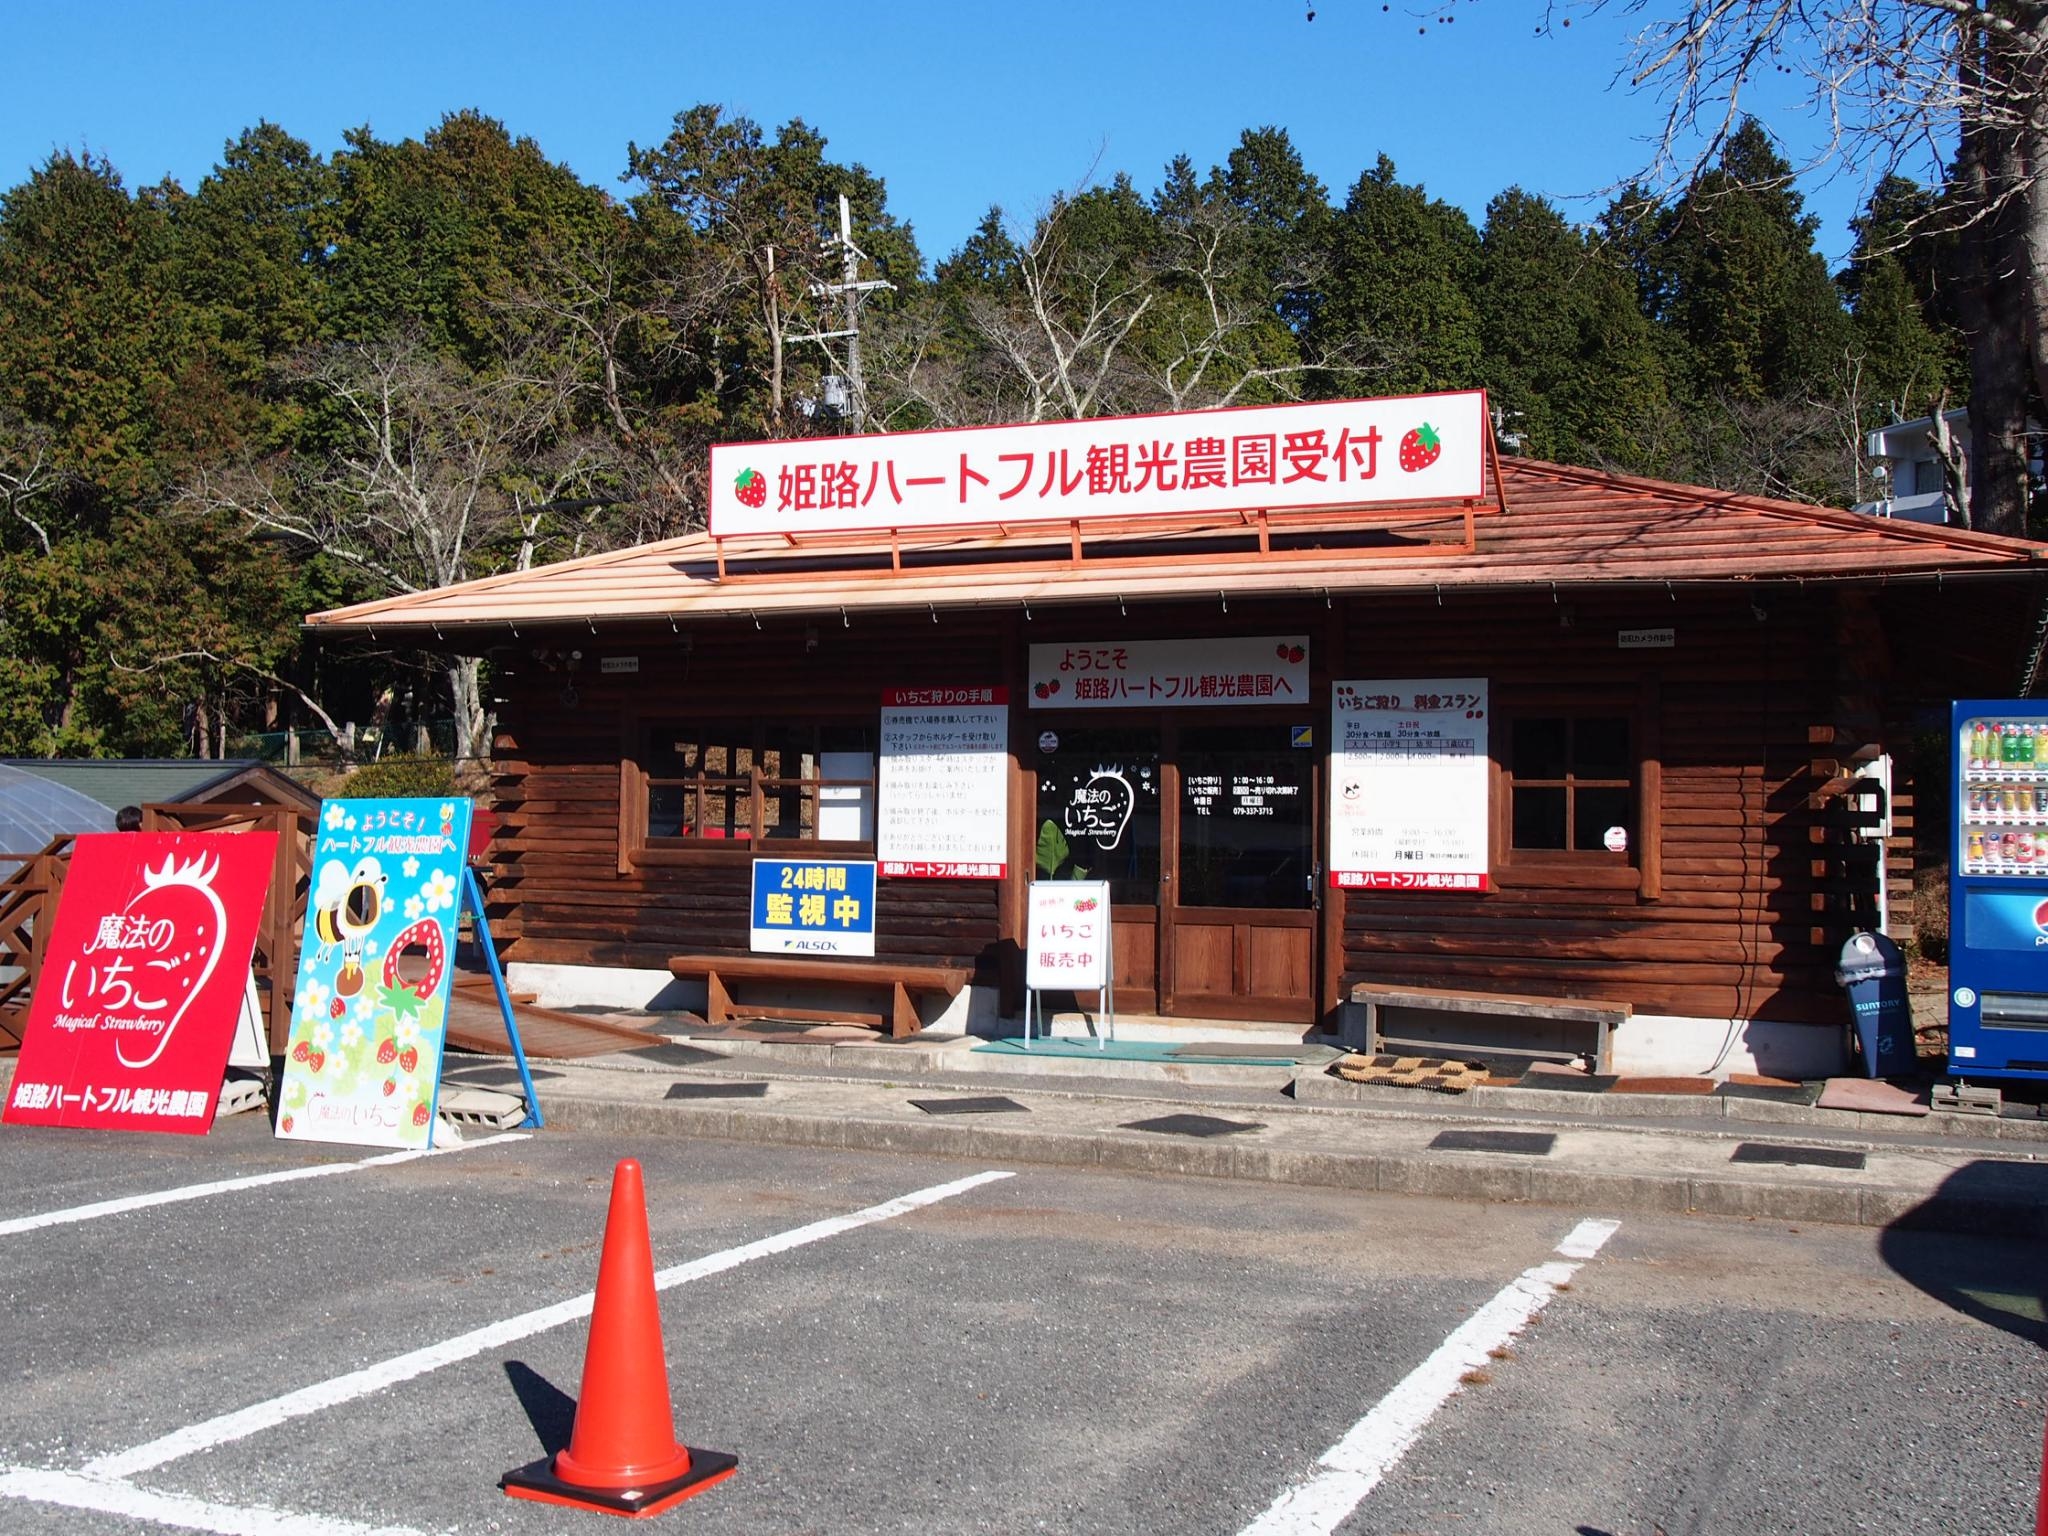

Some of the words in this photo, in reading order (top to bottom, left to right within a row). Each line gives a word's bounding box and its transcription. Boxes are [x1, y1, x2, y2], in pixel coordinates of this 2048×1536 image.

[777, 426, 1383, 513] 姫路ハートフル観光農園受付
[1060, 648, 1129, 671] ようこそ
[895, 688, 993, 704] いちご狩りの手順
[1075, 674, 1293, 700] 姫路ハートフル観光農園へ
[1338, 694, 1401, 711] いちご狩り
[1414, 693, 1481, 710] 料金プラン
[1069, 788, 1111, 806] 魔法の
[1064, 805, 1117, 828] いちご
[1196, 807, 1211, 816] TEL
[1233, 807, 1274, 816] 079-337-3715
[1065, 828, 1087, 838] Magical
[1087, 828, 1117, 838] Strawberry
[321, 834, 457, 855] ハートフル観光農園へ
[1394, 849, 1424, 860] 月曜日
[781, 866, 847, 891] 24時間
[883, 861, 1001, 878] 姫路ハートフル観光農園
[1338, 871, 1480, 889] 姫路ハートフル観光農園
[766, 893, 860, 927] 監視中
[84, 911, 176, 956] 魔法の
[1041, 923, 1094, 939] いちご
[796, 940, 838, 951] ALSOK
[1039, 951, 1094, 969] 販売中
[61, 954, 183, 1011] いちご
[52, 1012, 98, 1033] Magical
[100, 1013, 166, 1036] Strawberry
[12, 1081, 209, 1119] 姫路ハートフル観光農園
